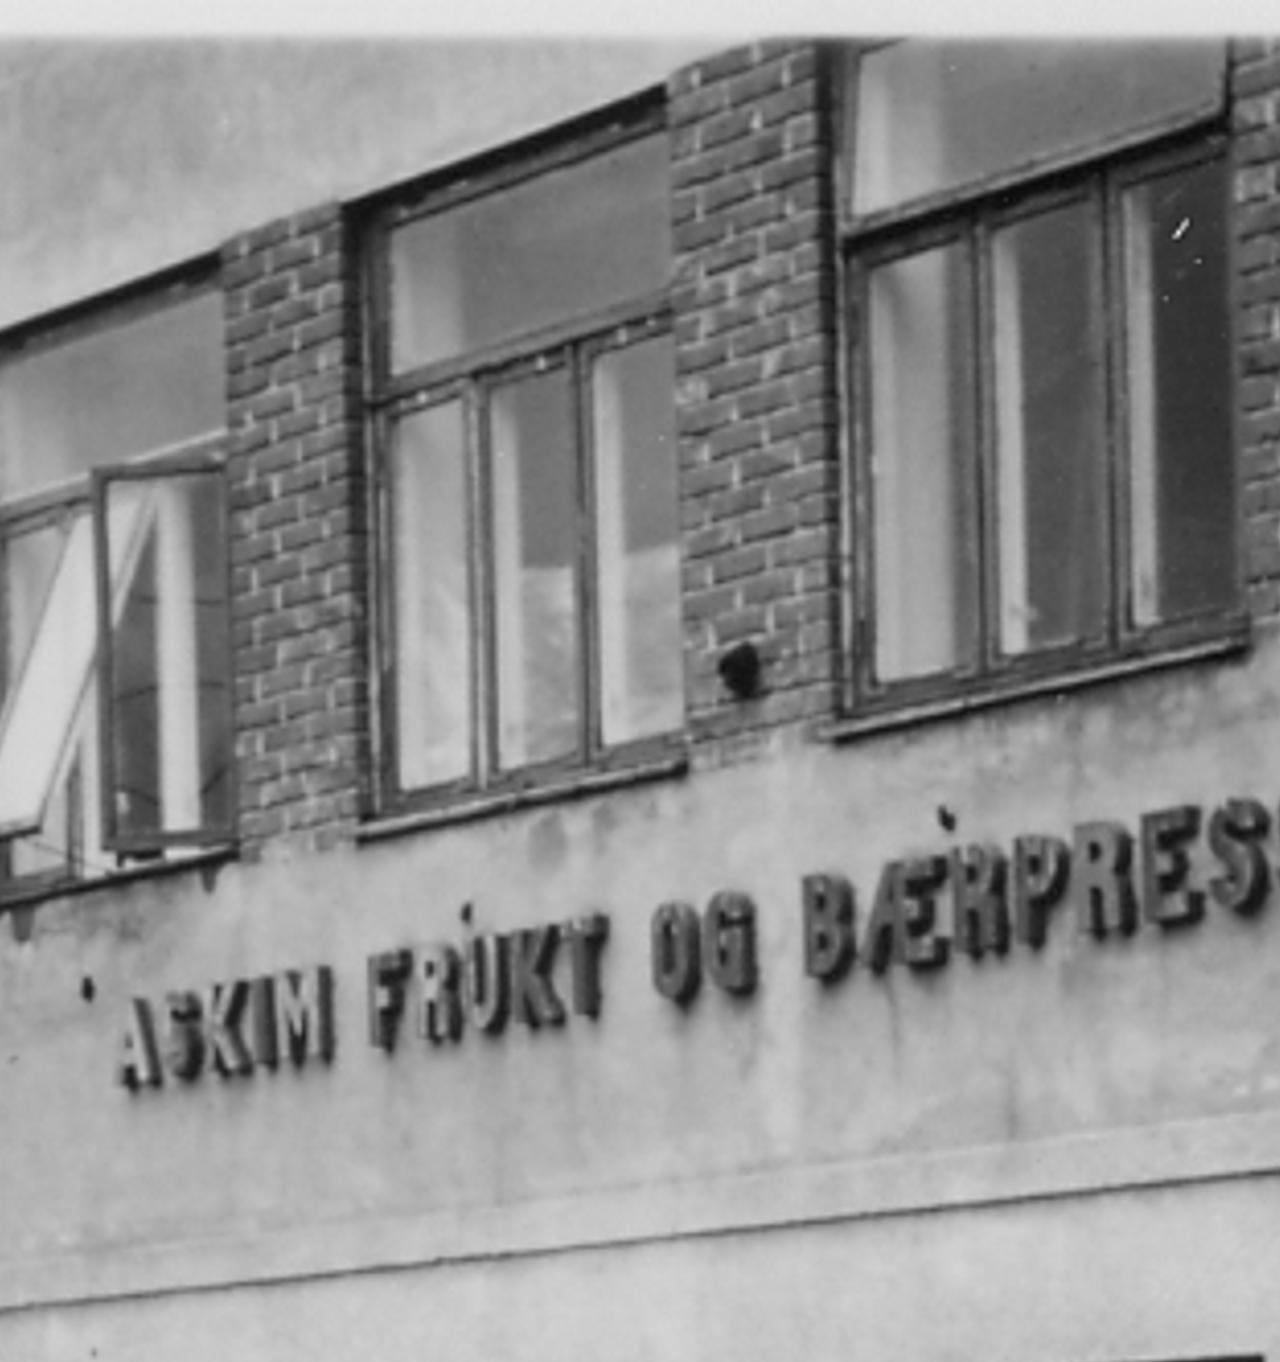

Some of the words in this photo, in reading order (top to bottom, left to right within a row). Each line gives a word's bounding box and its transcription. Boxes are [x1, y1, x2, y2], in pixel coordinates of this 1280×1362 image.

[120, 964, 336, 1090] ASKIM
[367, 912, 610, 1052] FRUKT
[650, 889, 758, 1006] OG
